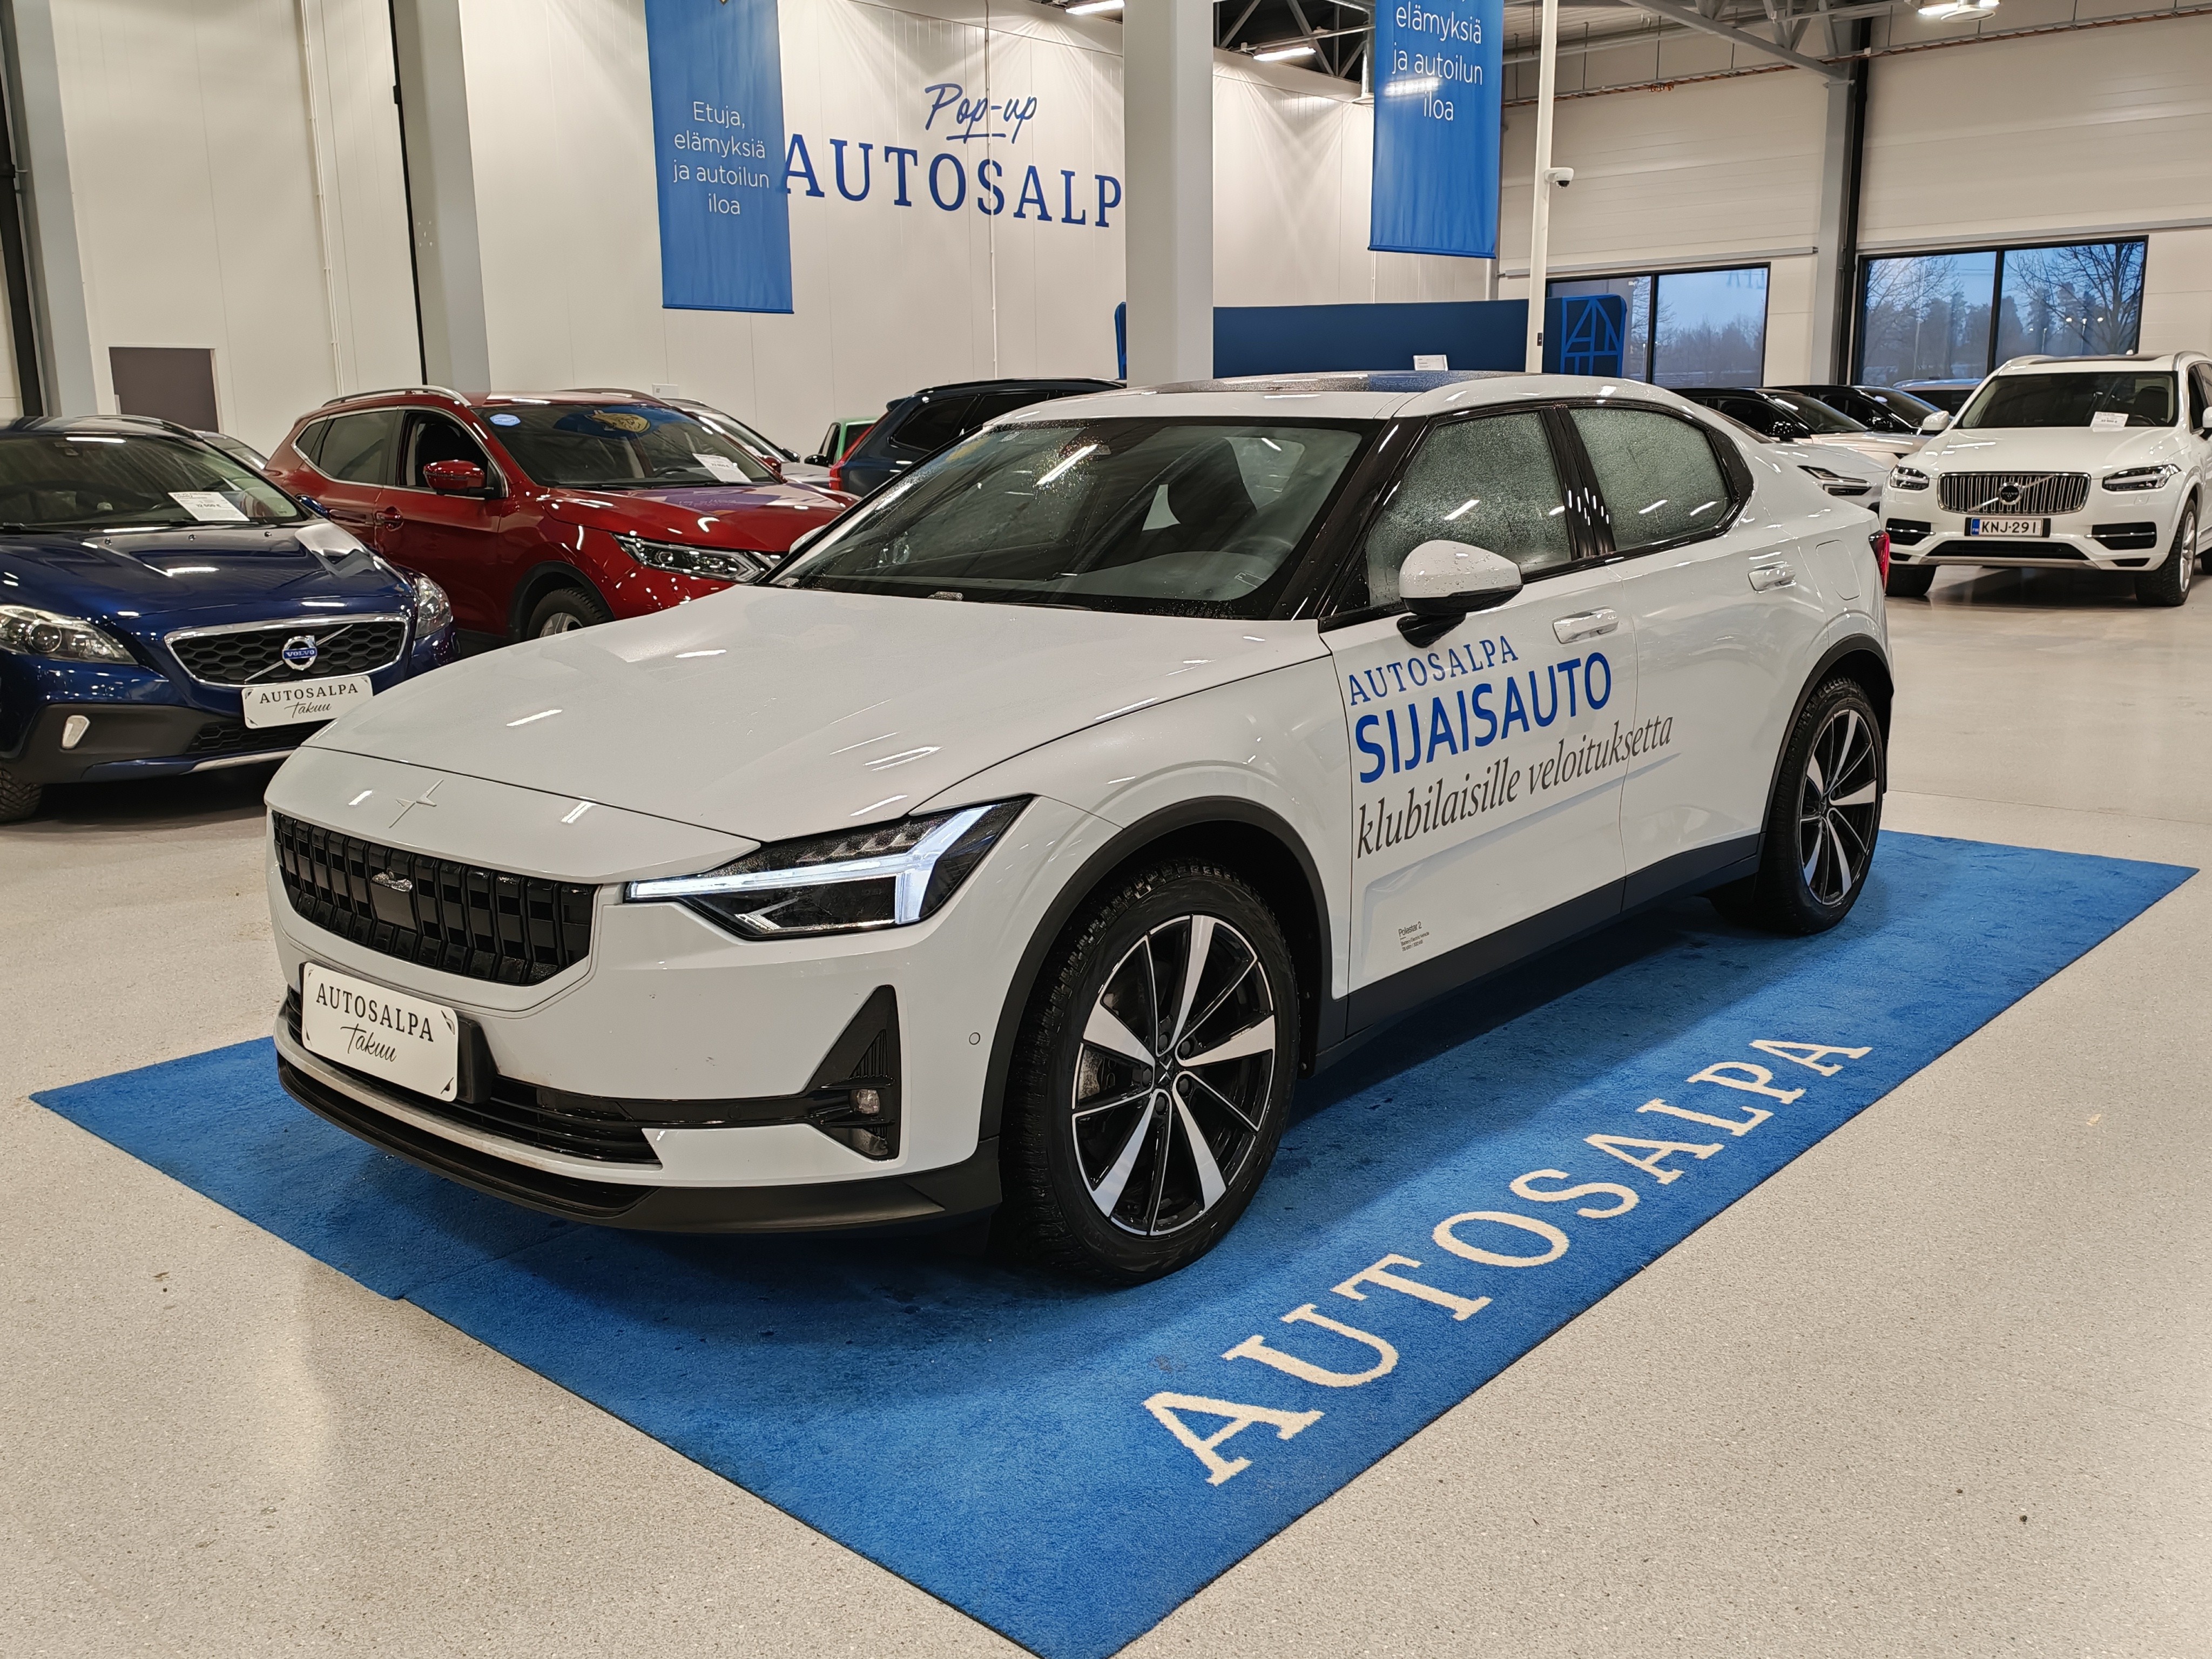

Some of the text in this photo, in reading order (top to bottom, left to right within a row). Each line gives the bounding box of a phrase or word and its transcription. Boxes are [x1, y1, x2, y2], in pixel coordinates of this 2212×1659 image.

[1396, 1, 1482, 44] elämyksiä
[1392, 42, 1483, 85] ja autoilun
[692, 101, 745, 129] Etuja,
[925, 83, 1037, 144] Pop-up
[1423, 90, 1454, 122] iloa
[673, 130, 766, 159] elämyksiä
[673, 159, 770, 189] ja autoilun
[707, 193, 740, 215] iloa
[1350, 635, 1519, 706] AUTOSALPA
[259, 683, 359, 704] AUTOSALPA
[284, 702, 333, 719] Takuu
[1355, 651, 1612, 783] SIJAISAUTO
[1357, 715, 1674, 859] klubilaisille veloituksetta
[1418, 921, 1422, 929] 2
[316, 982, 434, 1043] AUTOSALPA
[340, 1023, 397, 1062] Takuu
[1141, 1039, 1873, 1486] AUTOSALPA
